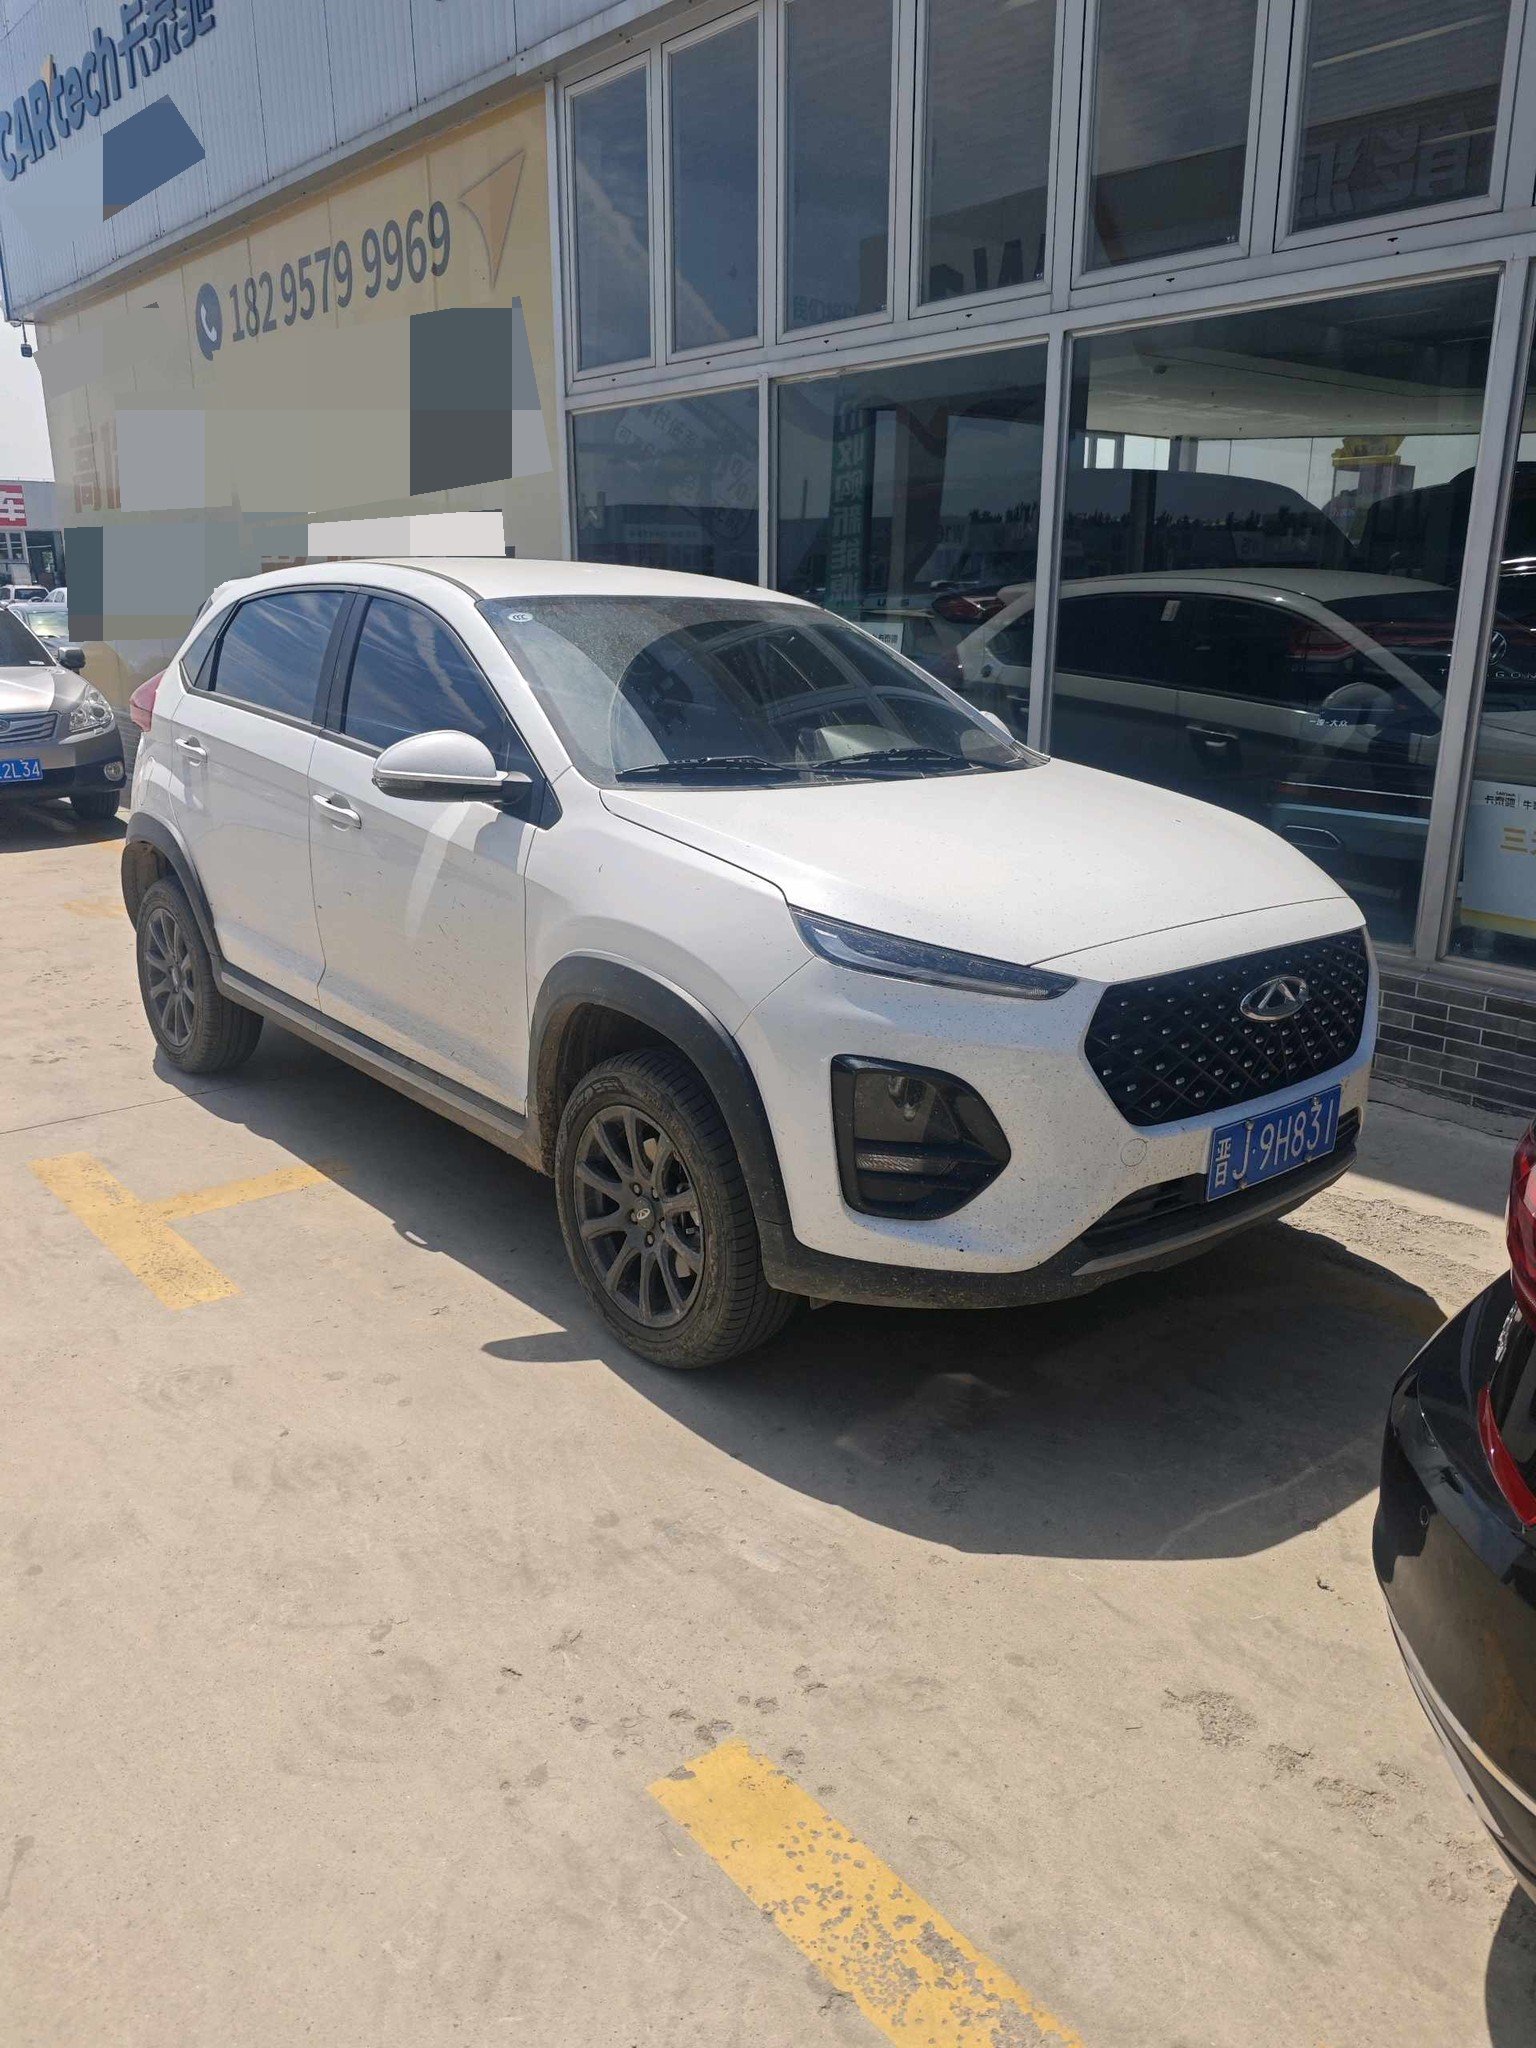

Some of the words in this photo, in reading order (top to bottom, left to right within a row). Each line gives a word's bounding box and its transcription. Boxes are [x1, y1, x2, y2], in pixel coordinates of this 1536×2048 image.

[229, 270, 278, 343] 182
[280, 240, 353, 327] 9579
[361, 200, 450, 298] 9969
[0, 760, 41, 780] 2L34
